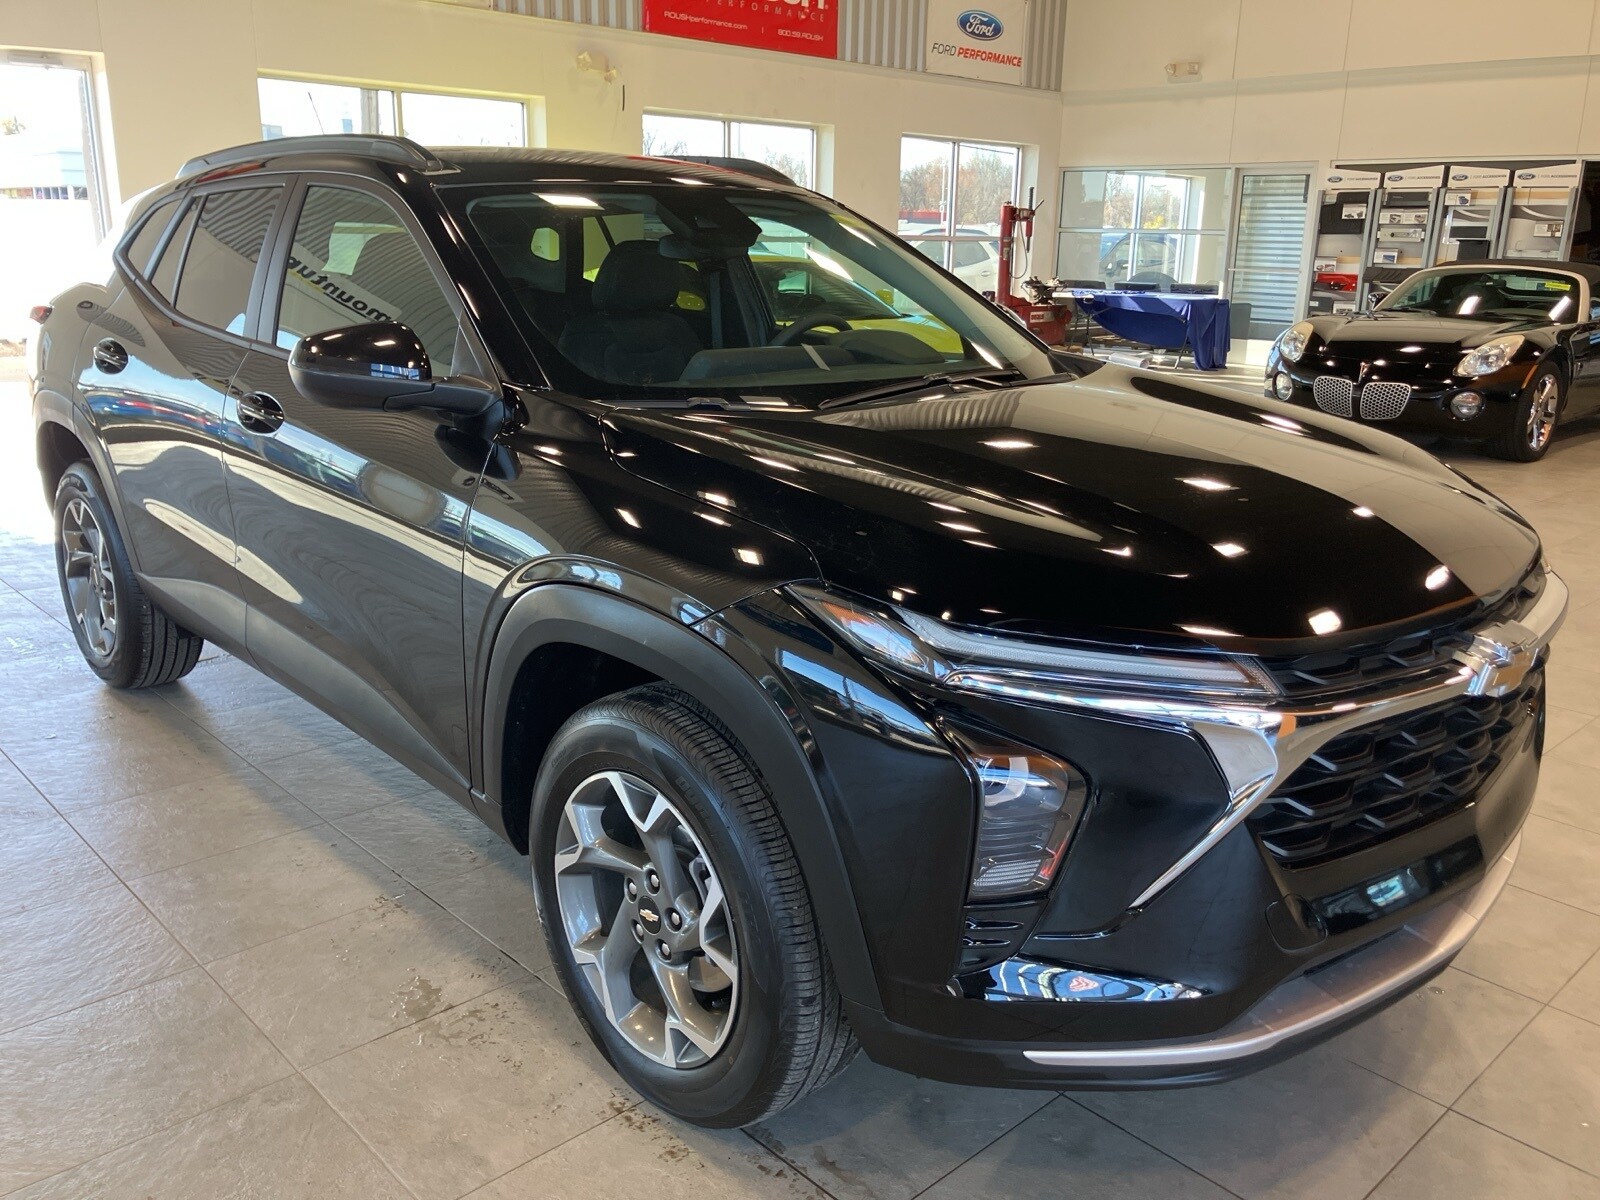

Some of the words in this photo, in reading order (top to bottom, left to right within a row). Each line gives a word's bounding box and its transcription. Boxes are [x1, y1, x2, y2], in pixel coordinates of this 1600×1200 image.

[706, 0, 824, 22] ERFORMANCE
[966, 14, 996, 37] Ford
[931, 42, 957, 56] FORD
[957, 47, 1022, 67] PERFORMANCE
